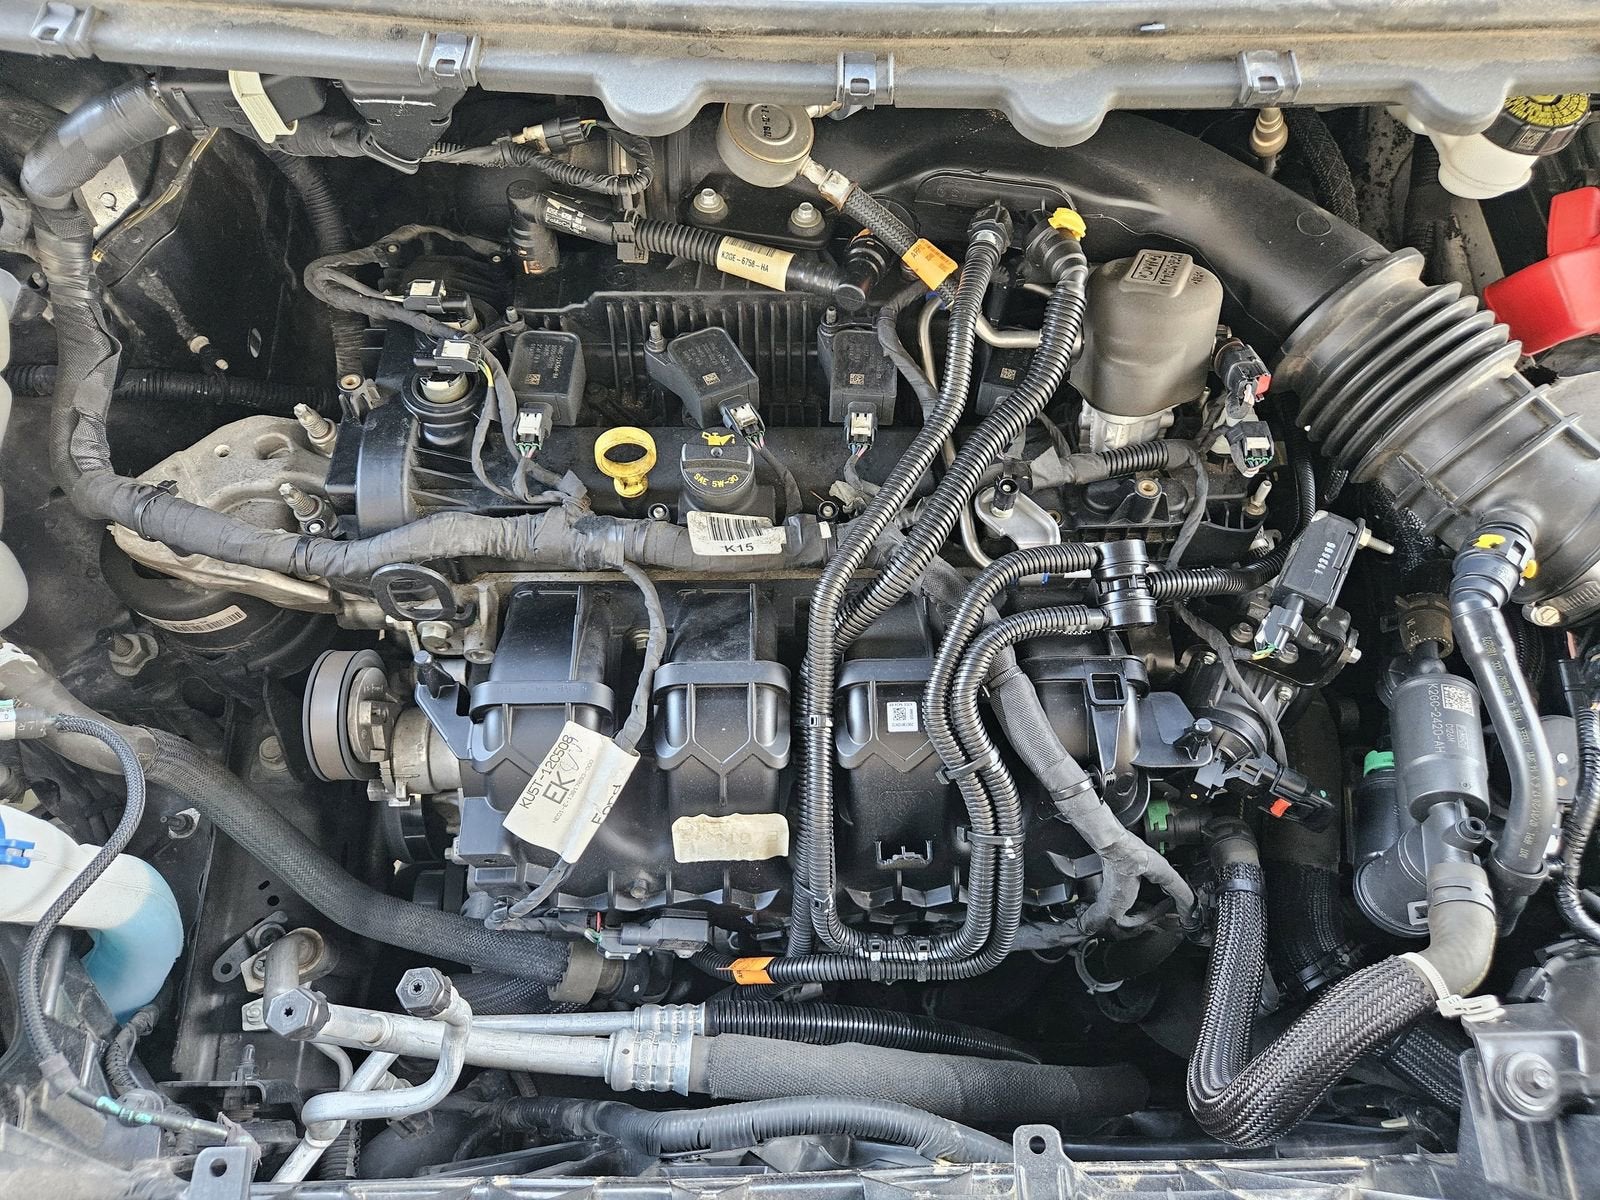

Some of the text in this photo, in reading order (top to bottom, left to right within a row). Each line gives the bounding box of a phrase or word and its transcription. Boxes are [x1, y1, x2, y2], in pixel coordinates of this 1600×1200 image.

[721, 251, 769, 272] K2GE-6758-HA
[693, 472, 739, 488] SAE 5W-30
[724, 542, 754, 553] K15
[1428, 683, 1446, 753] K2GC-2420-AH
[519, 734, 576, 809] KU5T-12C508
[542, 770, 576, 805] EK
